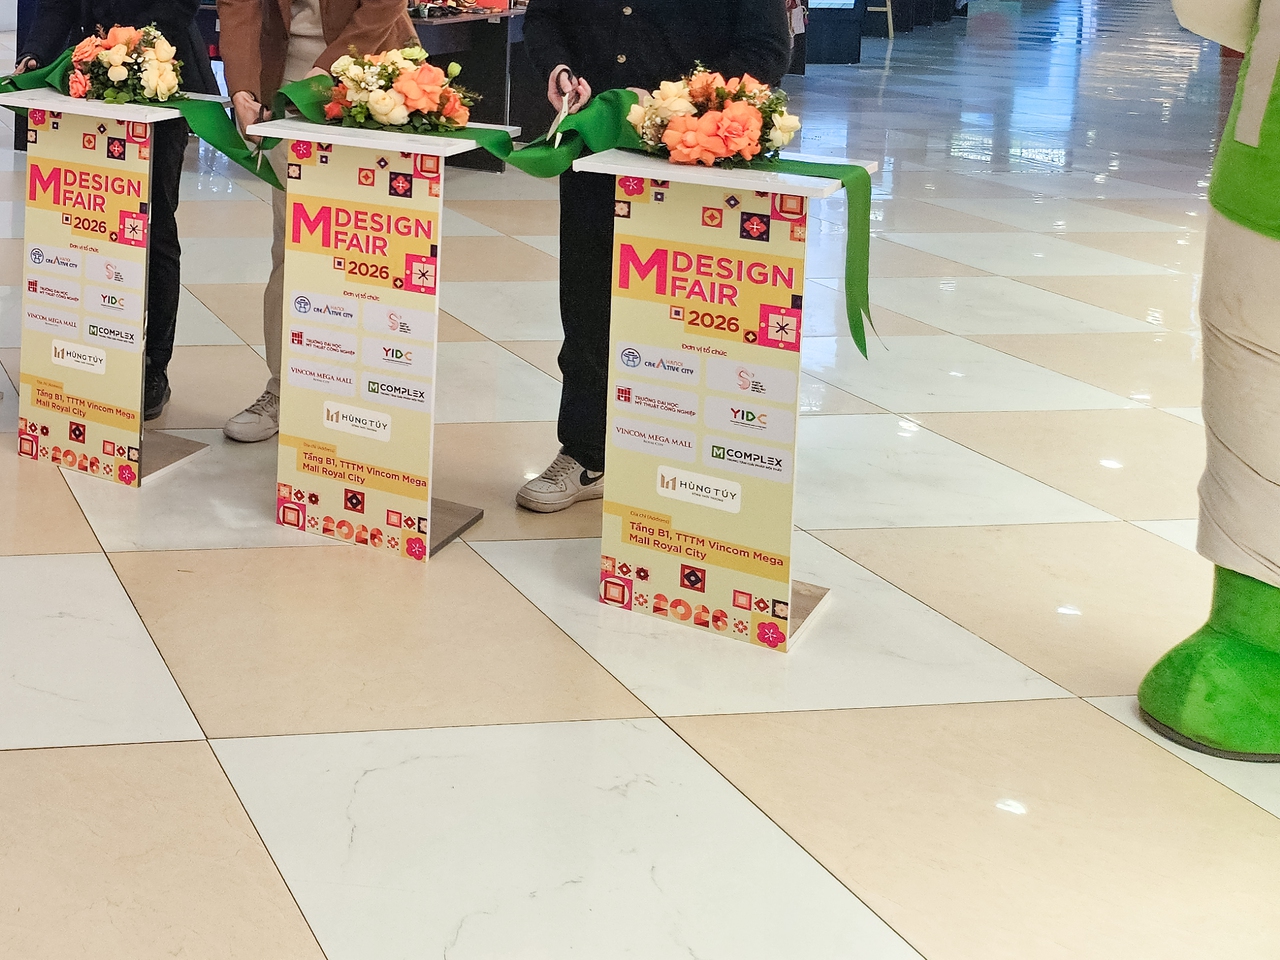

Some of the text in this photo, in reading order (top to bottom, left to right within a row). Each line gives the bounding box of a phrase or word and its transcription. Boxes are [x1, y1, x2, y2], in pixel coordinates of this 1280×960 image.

[28, 163, 142, 205] M DESIGN
[62, 189, 107, 214] FAIR
[73, 216, 107, 234] 2026
[291, 201, 433, 248] M DESIGN
[333, 230, 388, 258] FAIR
[347, 260, 390, 280] 2026
[618, 243, 795, 296] M DESIGN
[670, 276, 739, 308] FAIR
[687, 310, 740, 333] 2026
[382, 346, 413, 361] YIDC
[681, 343, 696, 351] Đơn
[711, 348, 728, 357] chức
[680, 367, 694, 375] CITY
[379, 383, 426, 400] COMPLEX
[341, 413, 388, 431] HÙNG TÚY
[730, 407, 768, 425] YIDC
[615, 426, 693, 449] VINCOM MEGA MALL
[726, 448, 783, 468] COMPLEX
[679, 480, 711, 495] HÙNG
[713, 488, 737, 501] TÚY
[629, 521, 784, 567] Tầng B1, TTTM Vincom Mega
[629, 533, 707, 561] Mall Royal City
